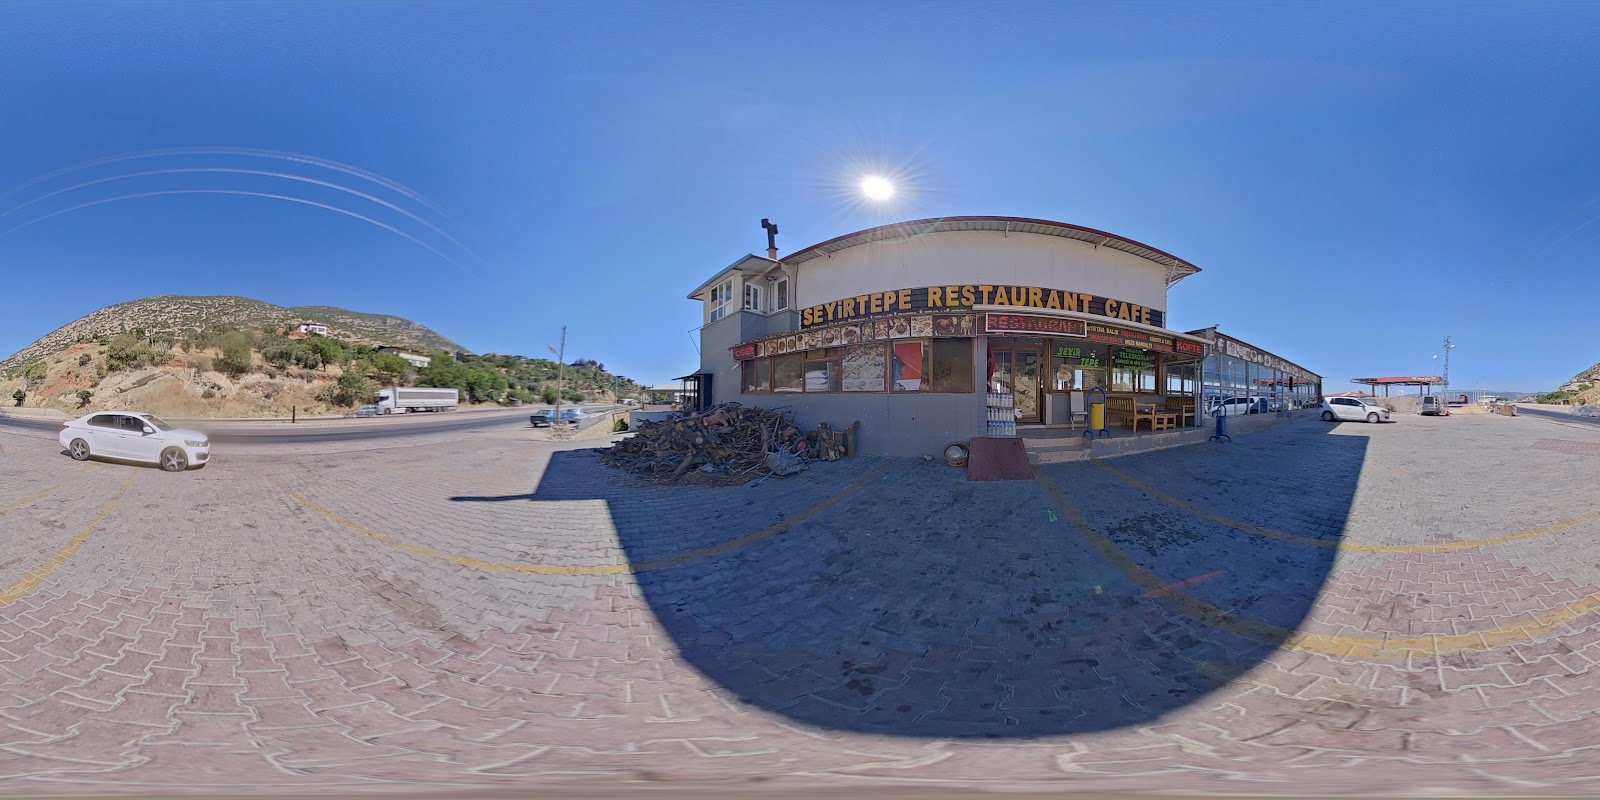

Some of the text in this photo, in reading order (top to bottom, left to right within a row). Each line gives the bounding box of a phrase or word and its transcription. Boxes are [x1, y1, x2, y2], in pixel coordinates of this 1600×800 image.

[928, 285, 1092, 314] RESTAURANT
[1105, 298, 1151, 325] CAFE
[1080, 358, 1100, 367] TEPE
